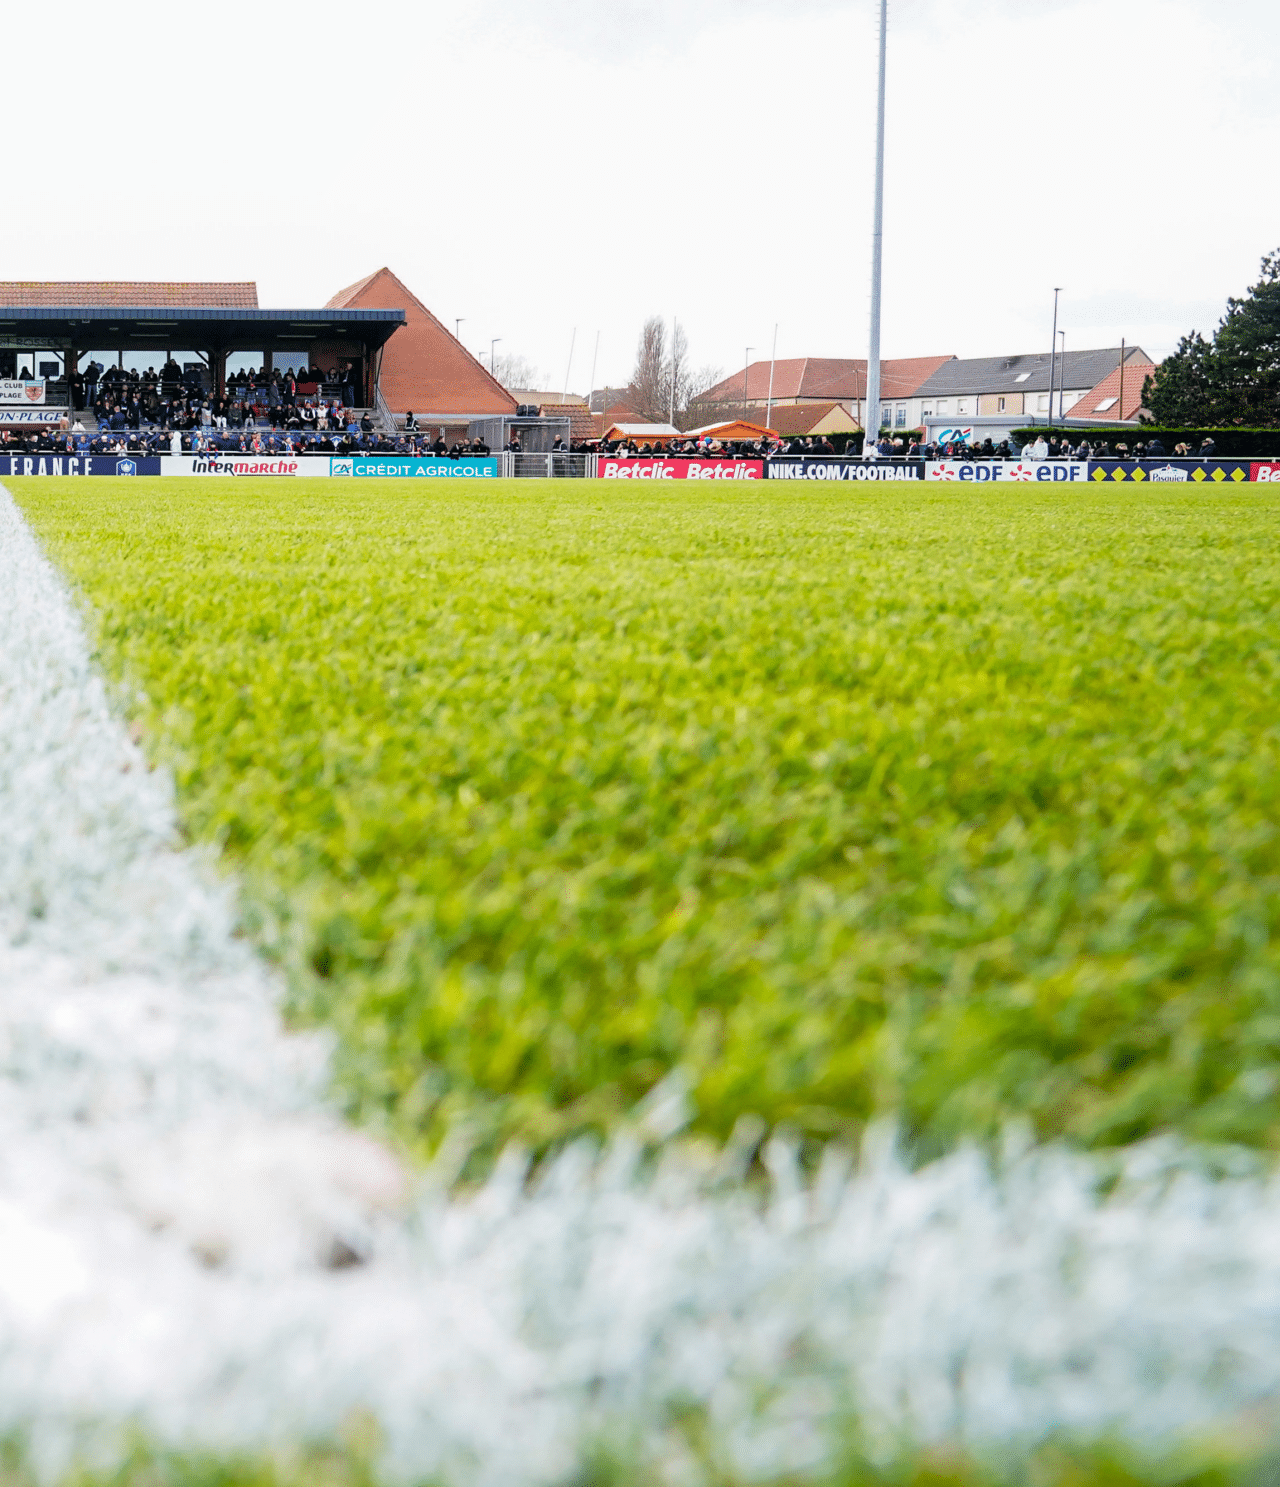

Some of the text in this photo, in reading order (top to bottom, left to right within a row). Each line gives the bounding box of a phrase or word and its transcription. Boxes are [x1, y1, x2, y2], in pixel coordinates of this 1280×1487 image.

[10, 458, 93, 476] FRANCE
[355, 462, 492, 476] CRÉDIT AGRICOLE
[603, 462, 675, 479] Betclic
[687, 463, 758, 479] Betclic
[768, 464, 919, 480] NIKE.COM/FOOTBALL
